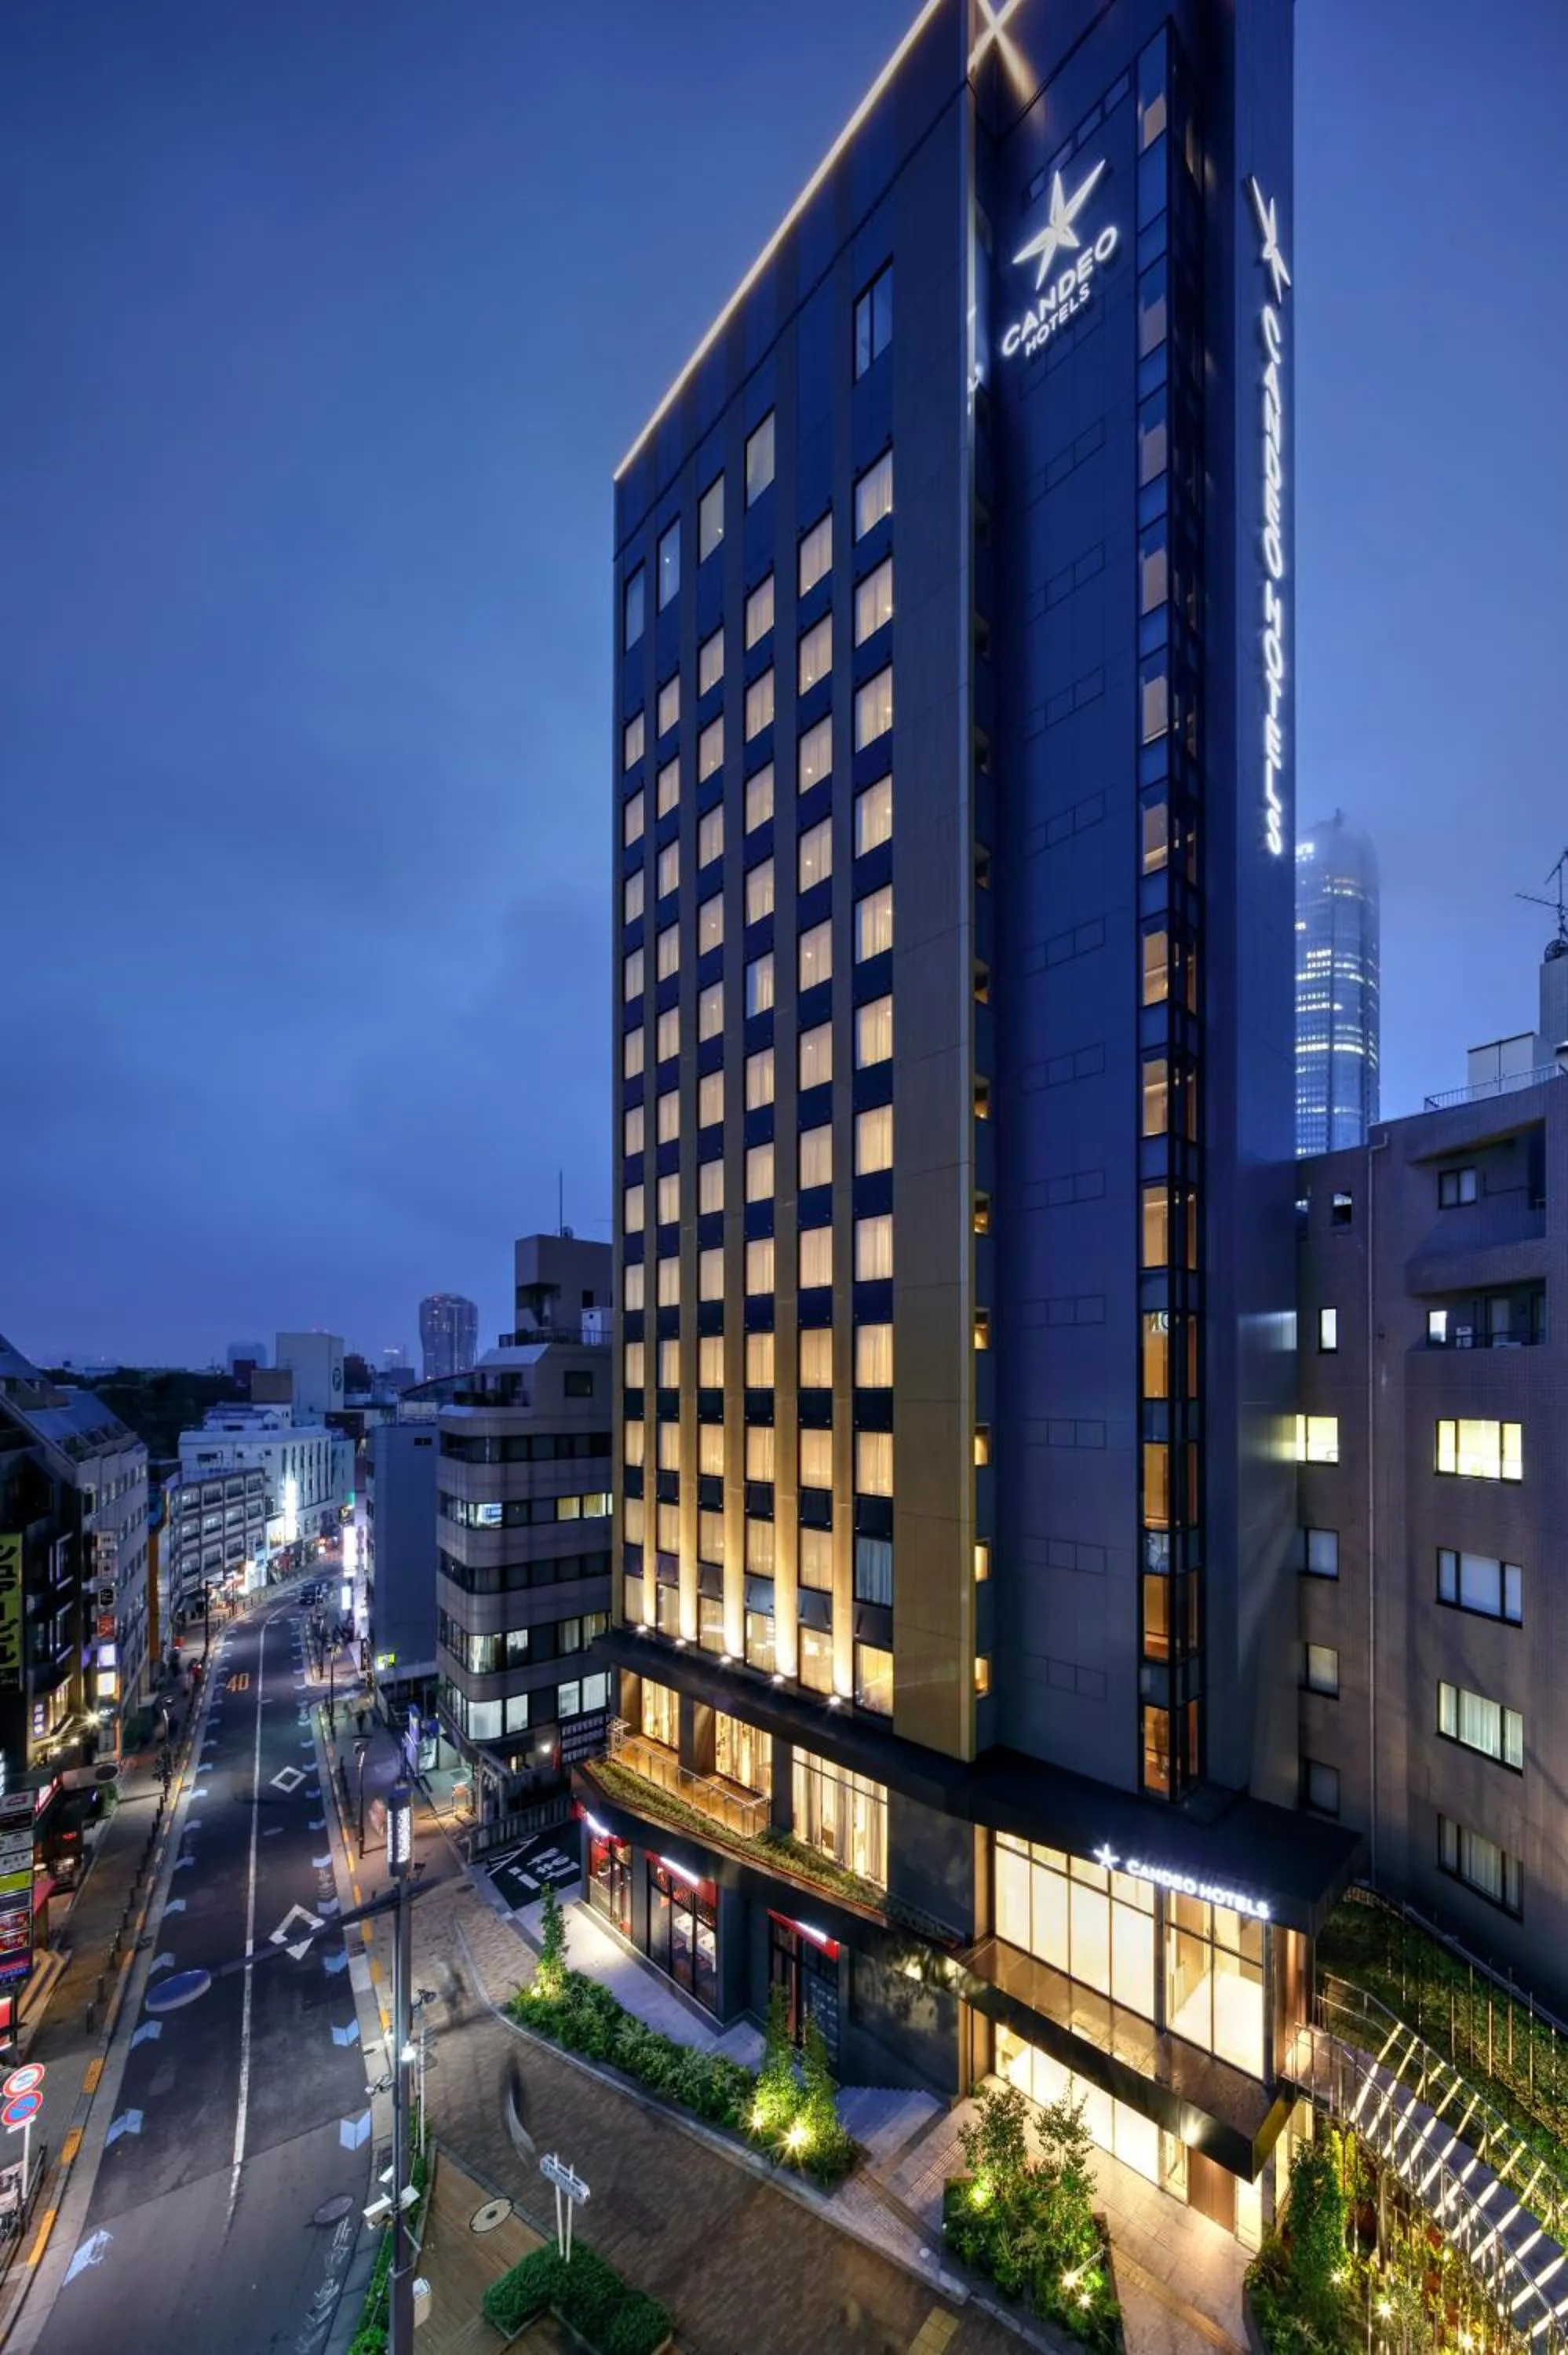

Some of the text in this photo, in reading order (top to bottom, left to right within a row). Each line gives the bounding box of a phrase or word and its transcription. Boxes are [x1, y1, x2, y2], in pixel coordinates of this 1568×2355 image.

[1001, 226, 1118, 356] CANDEO
[1025, 283, 1091, 356] HOTELS
[225, 1673, 250, 1692] 40
[1125, 1859, 1271, 1921] CANDEO HOTELS
